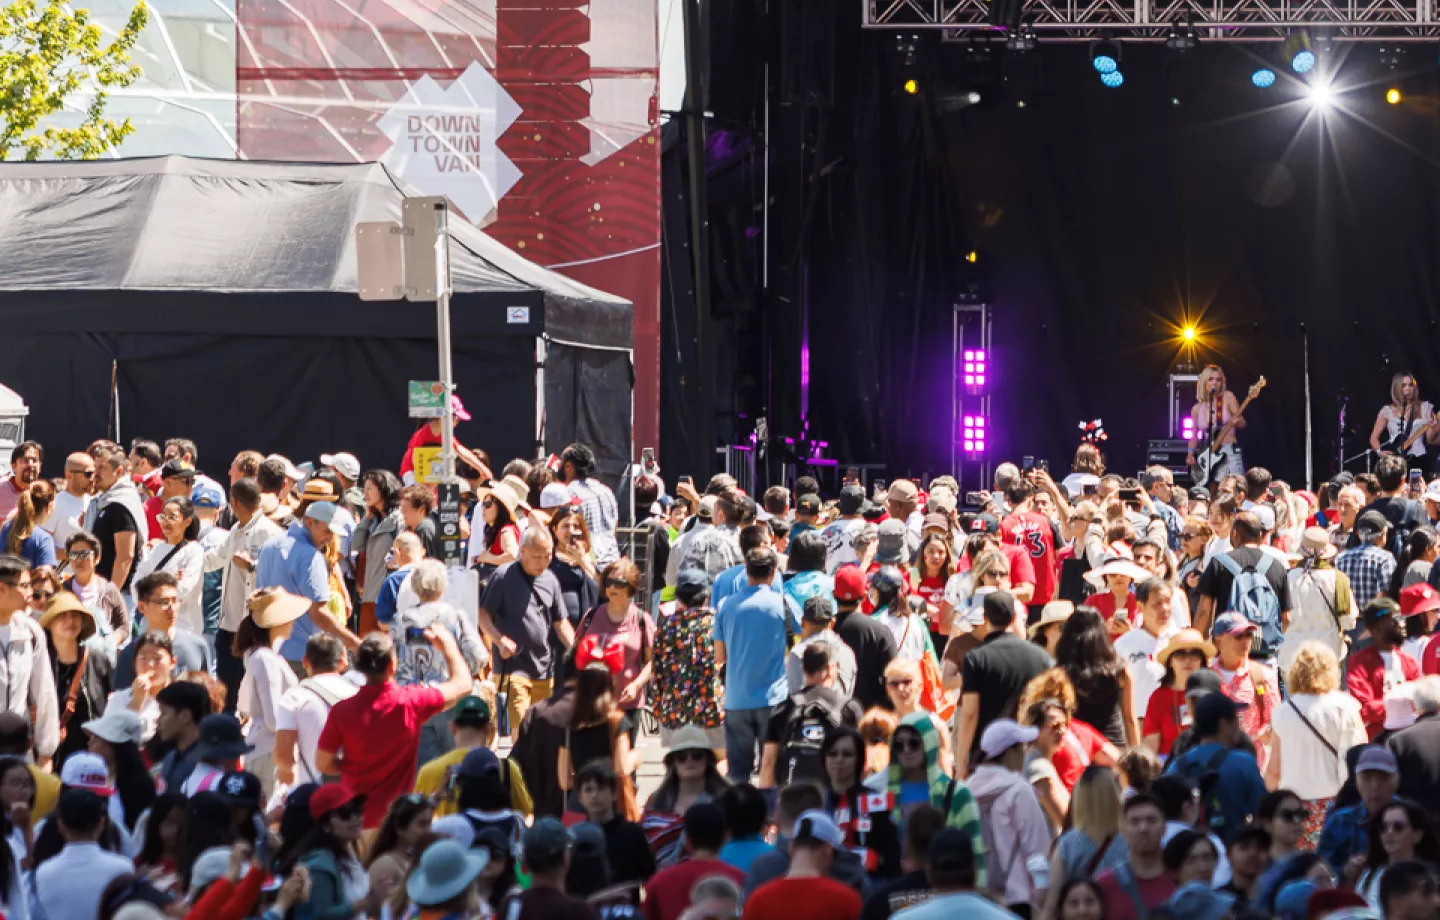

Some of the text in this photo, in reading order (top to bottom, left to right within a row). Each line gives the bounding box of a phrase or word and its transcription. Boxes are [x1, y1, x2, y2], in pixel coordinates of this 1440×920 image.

[408, 115, 480, 133] DOWN
[408, 136, 480, 153] TOWN
[434, 154, 480, 173] VAN
